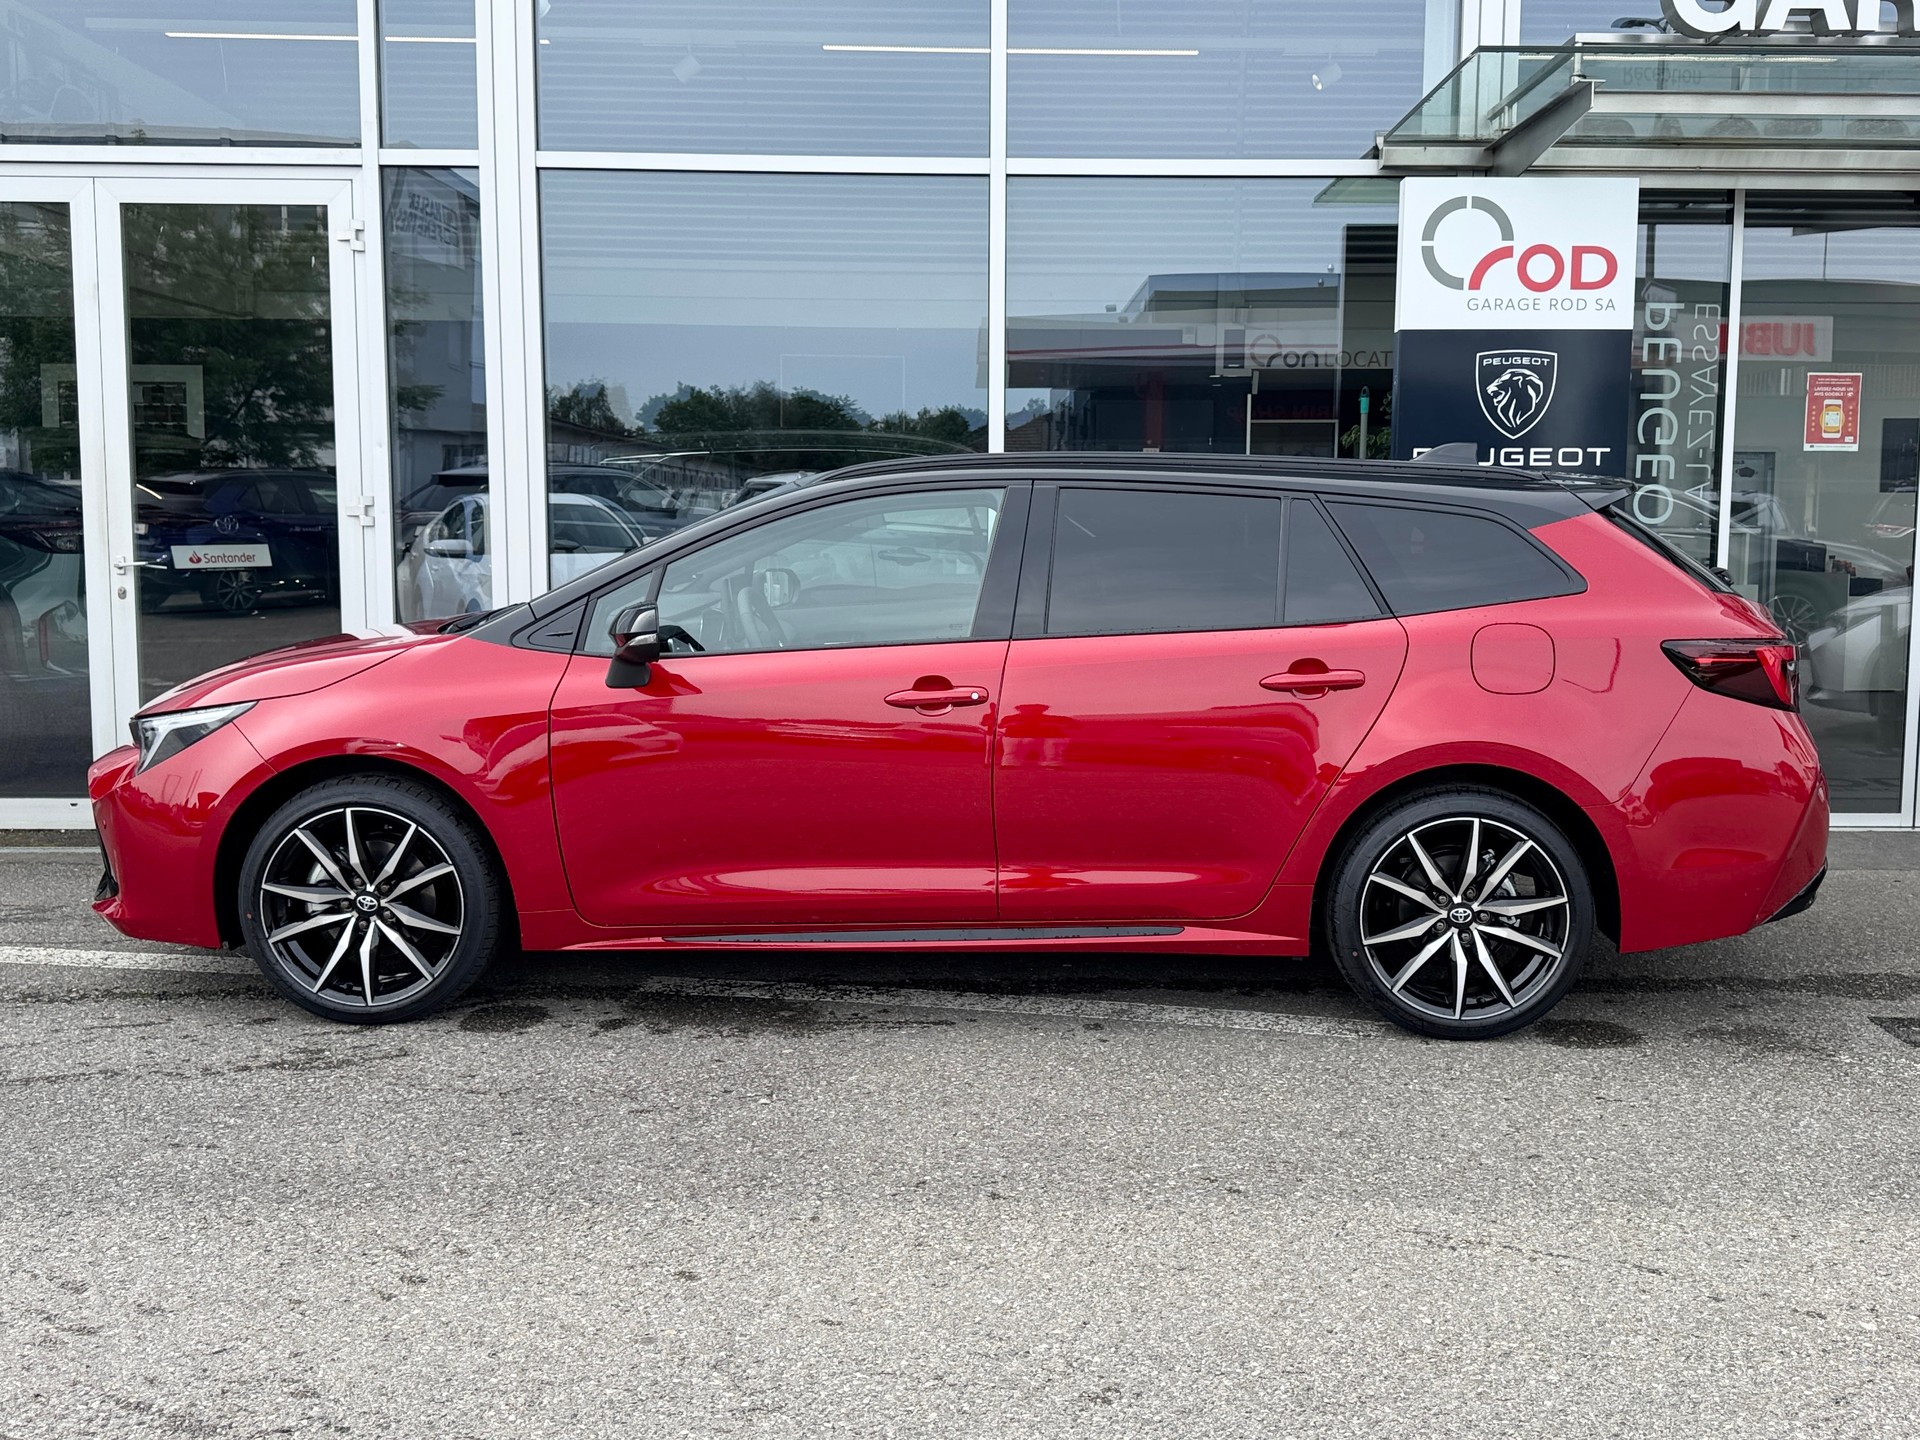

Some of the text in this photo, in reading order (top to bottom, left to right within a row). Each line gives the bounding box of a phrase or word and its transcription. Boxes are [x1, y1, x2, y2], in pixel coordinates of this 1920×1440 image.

[1466, 297, 1616, 311] GARAGE ROD SA
[1482, 356, 1551, 366] PEUGEOT
[203, 552, 256, 564] Santander
